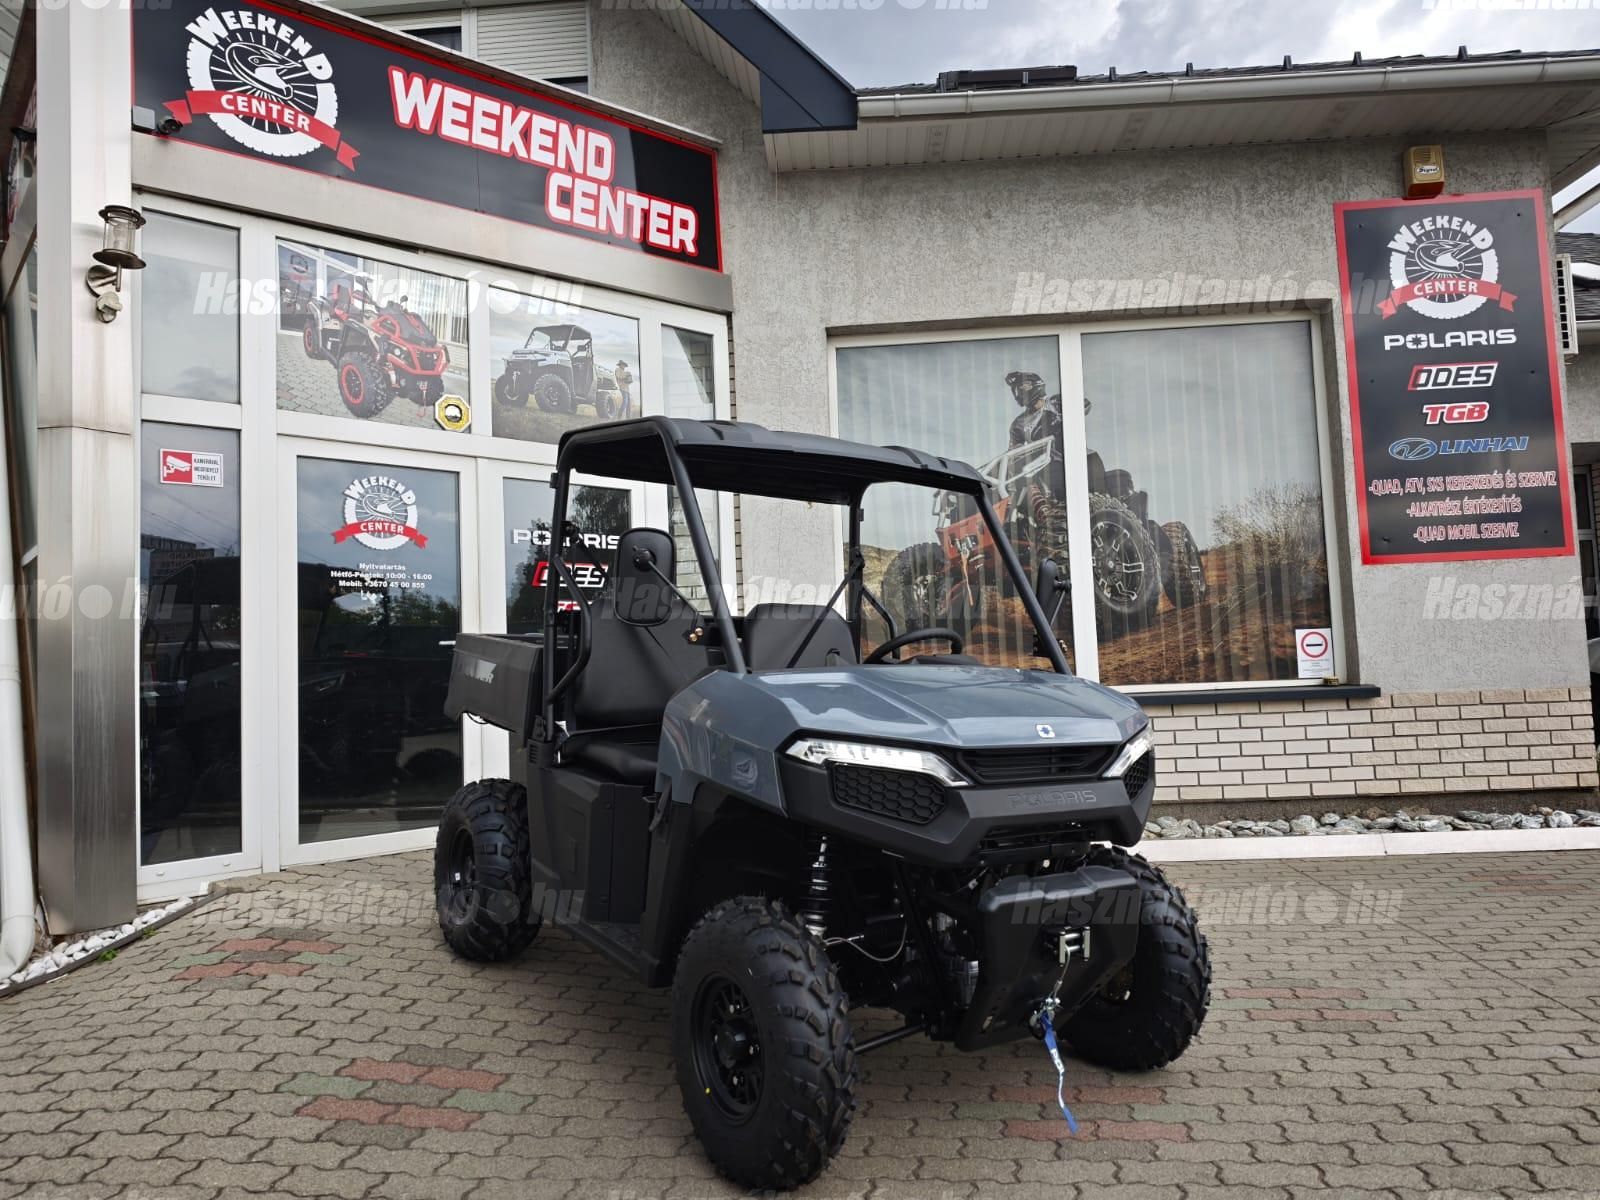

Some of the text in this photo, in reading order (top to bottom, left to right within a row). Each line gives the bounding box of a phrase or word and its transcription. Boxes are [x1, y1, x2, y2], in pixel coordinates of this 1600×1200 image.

[185, 7, 333, 82] WEEKEND
[220, 93, 311, 133] CENTER
[390, 68, 613, 180] WEEKEND
[547, 173, 697, 253] CENTER
[1388, 215, 1494, 256] WEEKEND
[1413, 280, 1478, 296] CENTER
[1383, 328, 1517, 350] POLARIS
[1408, 362, 1498, 391] ODES
[1423, 402, 1489, 425] TGB
[1439, 437, 1529, 456] LINHAI
[344, 475, 416, 506] WEEKEND
[360, 522, 404, 534] CENTER
[512, 529, 620, 549] PORIS
[1007, 790, 1097, 809] POLARIS
